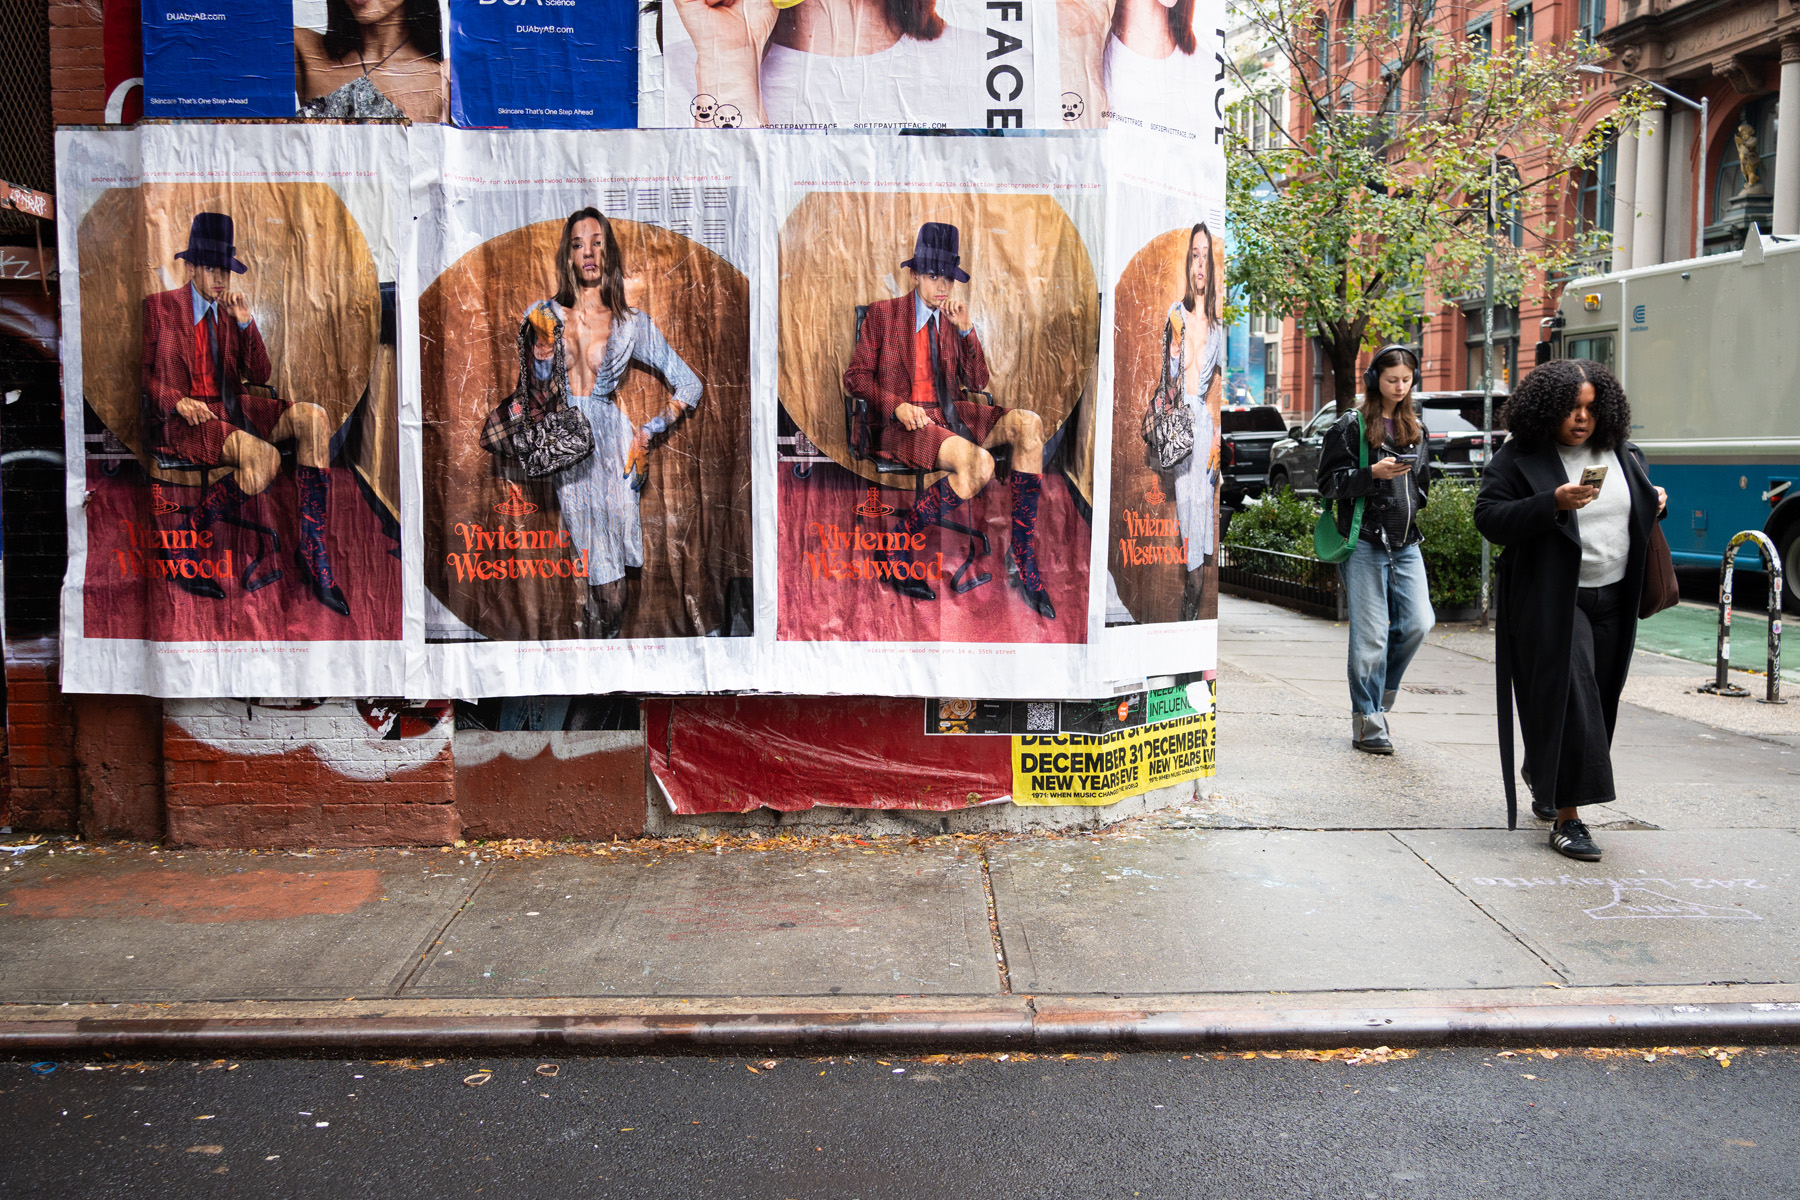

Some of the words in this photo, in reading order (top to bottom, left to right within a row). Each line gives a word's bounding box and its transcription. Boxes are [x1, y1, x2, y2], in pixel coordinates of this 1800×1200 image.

[166, 12, 226, 22] DUAbyAB.com
[516, 25, 574, 34] DUAbyAB.com
[986, 1, 1023, 129] FACE
[150, 97, 177, 105] Skincare
[178, 97, 197, 105] That's
[212, 98, 227, 106] Step
[498, 107, 524, 115] Skincare
[558, 108, 573, 117] Step
[271, 170, 313, 178] photographed
[316, 170, 324, 178] by
[627, 175, 669, 183] photographed
[454, 522, 571, 552] Vivienne
[808, 521, 927, 551] Vivienne
[1123, 508, 1180, 539] Vivienne
[446, 549, 590, 584] Westwood
[800, 552, 944, 582] Westwood
[1119, 537, 1189, 569] Westwood
[1021, 747, 1126, 773] DECEMBER
[1129, 743, 1143, 765] 31
[1144, 729, 1208, 759] DECEMBER
[1149, 757, 1171, 776] NEW
[1172, 750, 1201, 769] YEARS
[1031, 775, 1074, 791] NEW
[1077, 772, 1119, 790] YEARS
[1120, 766, 1139, 785] EVE
[1125, 782, 1139, 791] WORLD
